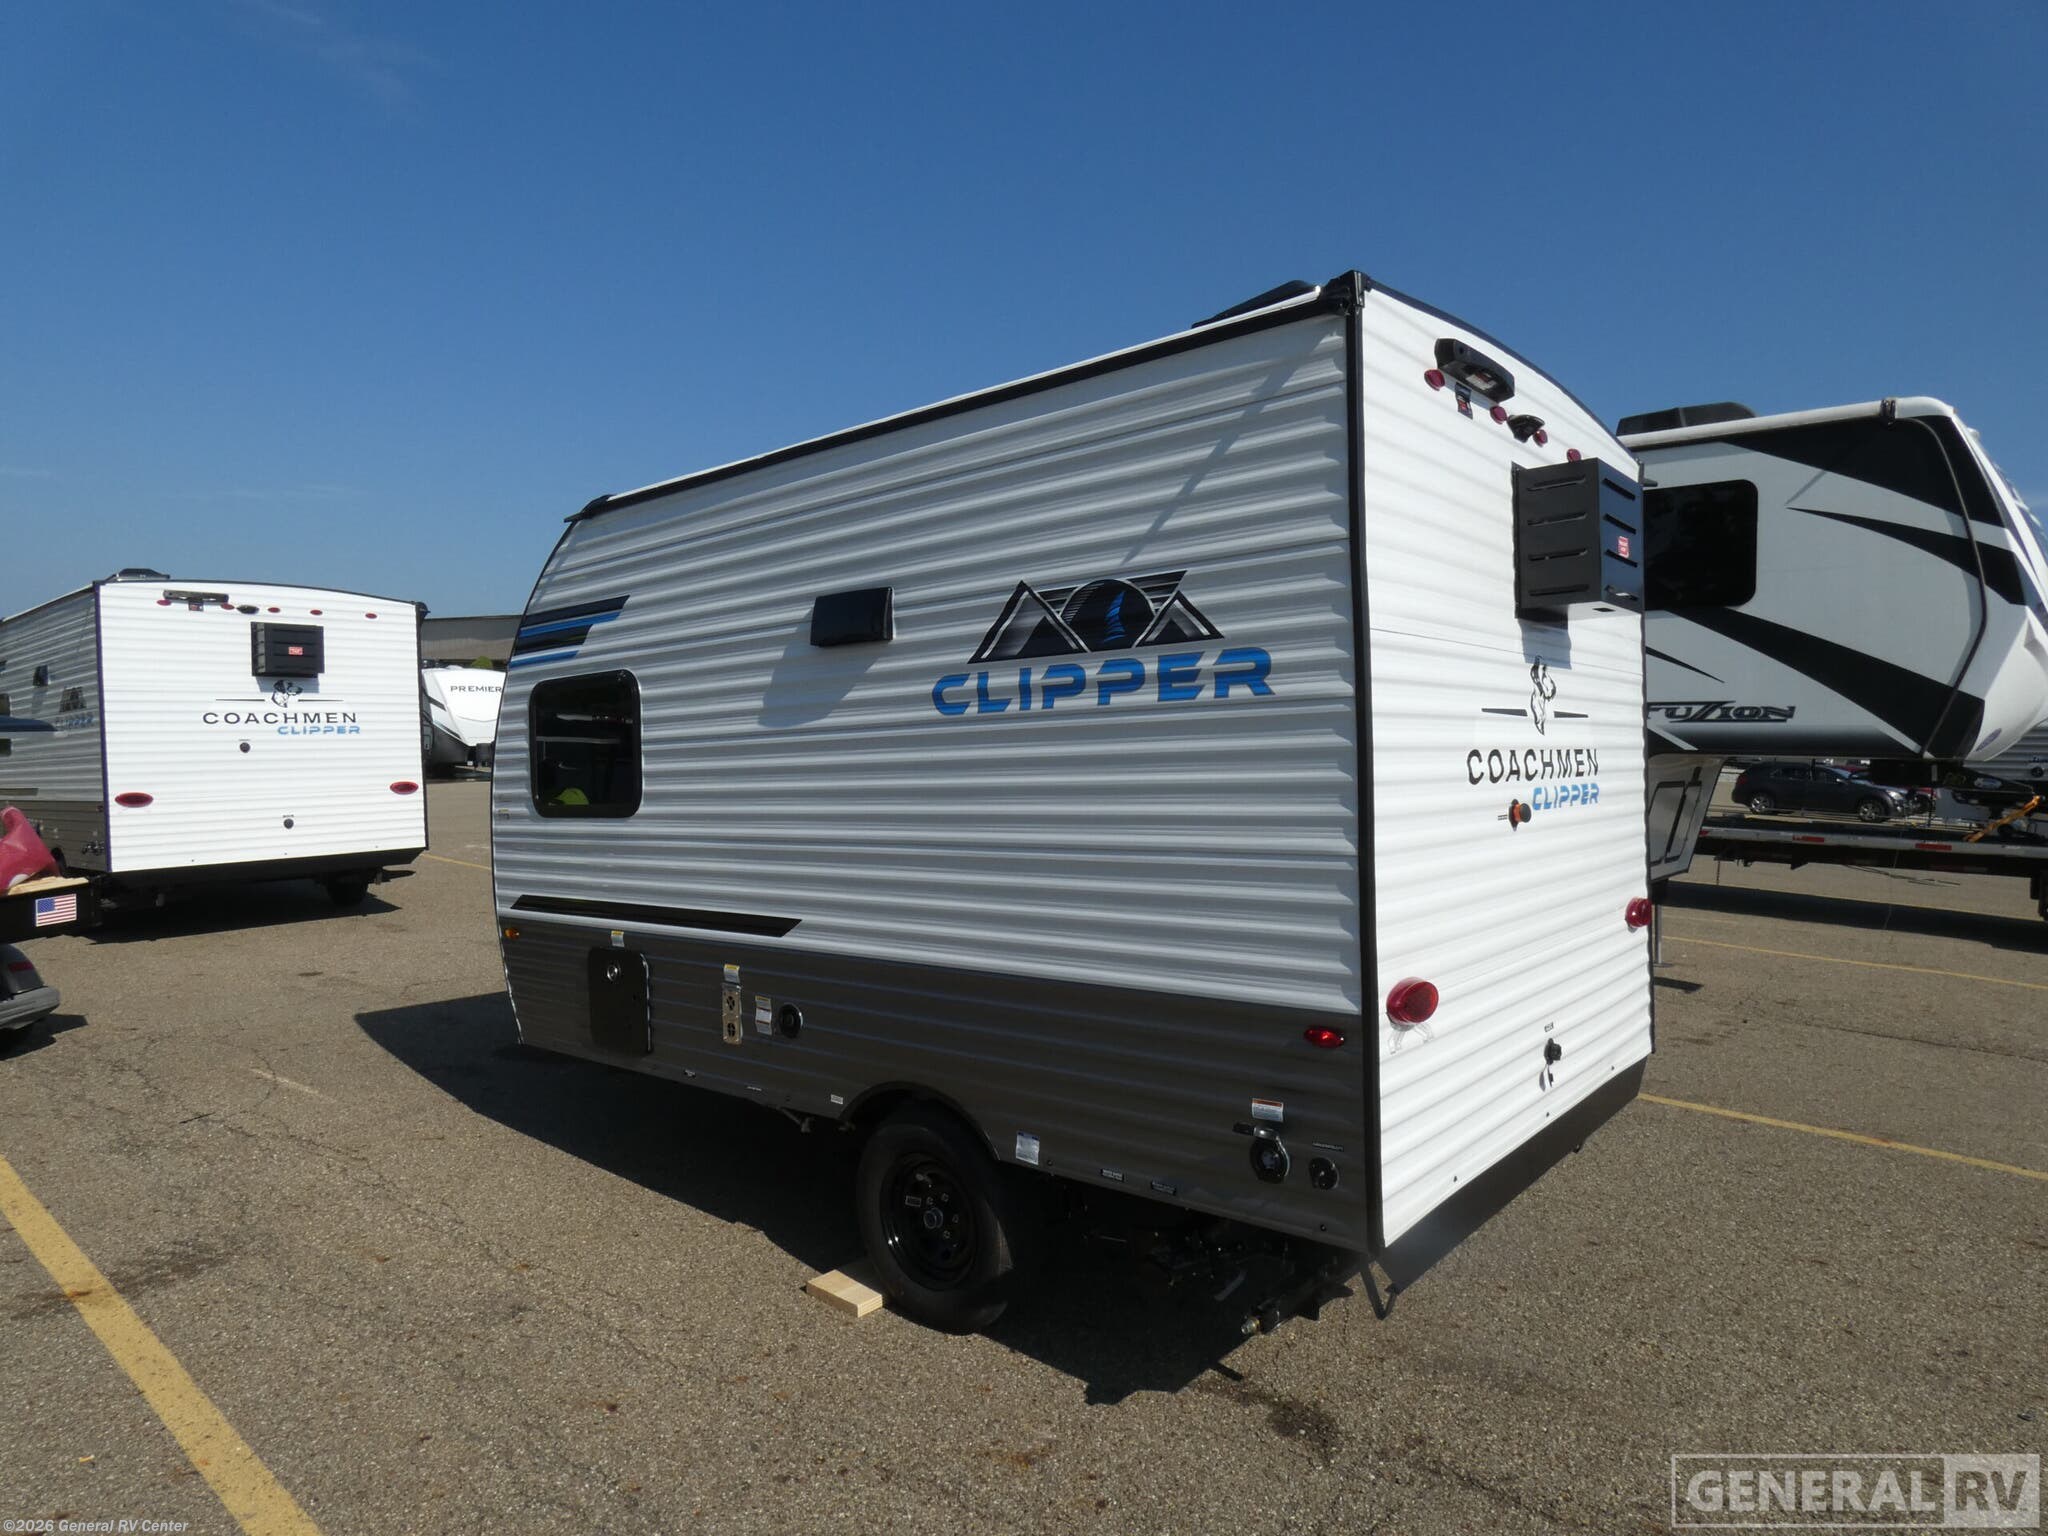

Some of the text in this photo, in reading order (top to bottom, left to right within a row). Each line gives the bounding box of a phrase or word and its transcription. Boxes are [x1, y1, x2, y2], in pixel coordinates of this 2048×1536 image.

[450, 685, 502, 693] PREMIER
[931, 646, 1276, 716] CLIPPER
[202, 712, 358, 725] COACHMEN
[277, 726, 361, 735] CLIPPER
[1466, 748, 1599, 785] COACHMEN
[1532, 782, 1600, 811] CLIPPER
